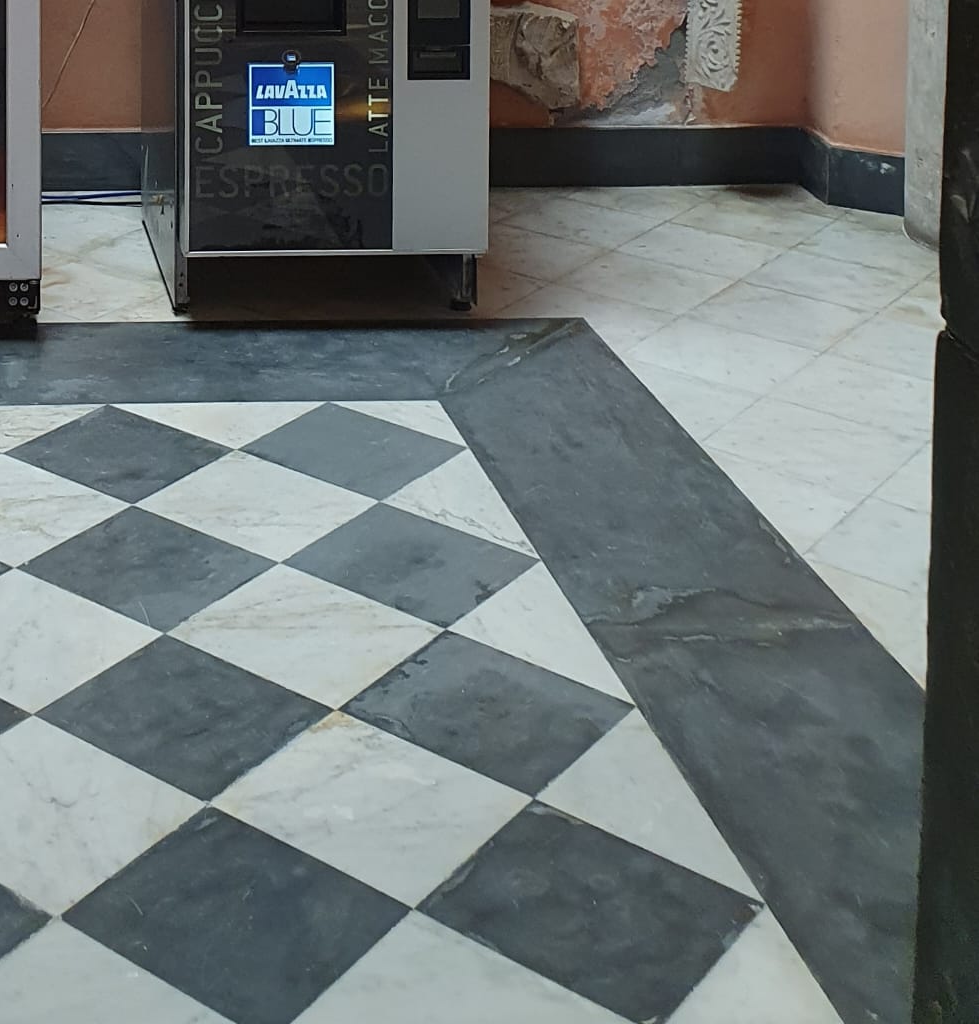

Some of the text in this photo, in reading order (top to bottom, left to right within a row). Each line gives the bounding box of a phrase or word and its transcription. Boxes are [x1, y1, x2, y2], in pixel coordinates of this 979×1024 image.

[256, 80, 327, 99] LAVAZZA
[252, 108, 332, 136] BLUE
[368, 78, 389, 153] LATTE
[194, 163, 389, 199] ESPRESSO
